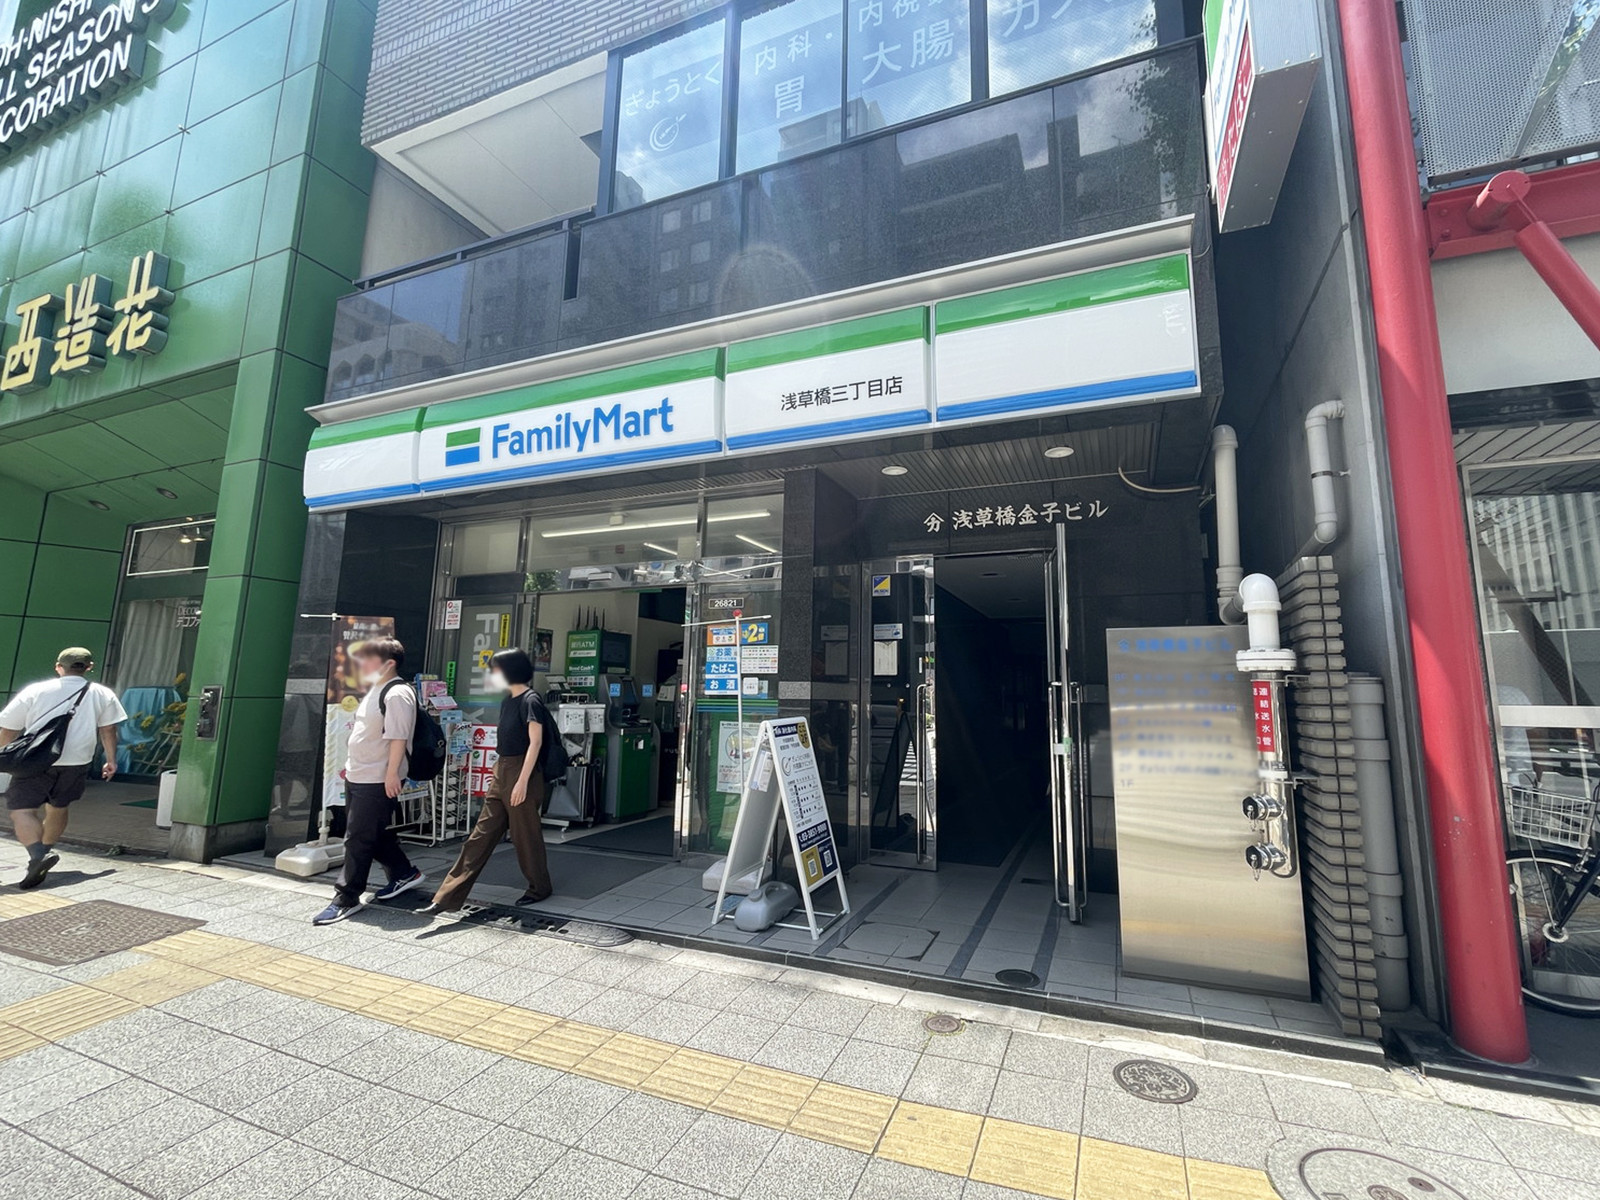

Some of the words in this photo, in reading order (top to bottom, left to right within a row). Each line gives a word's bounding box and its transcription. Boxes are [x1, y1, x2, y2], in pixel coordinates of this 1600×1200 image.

[774, 75, 805, 118] 胃
[862, 19, 955, 84] 大腸
[625, 62, 721, 117] ぎょうとく
[781, 376, 903, 412] 浅草橋三丁目店
[492, 397, 674, 459] FamilyMart
[952, 500, 1110, 531] 浅草橋金子ビル
[714, 599, 737, 608] 26821
[710, 680, 735, 690] お酒
[711, 663, 736, 674] たばこ
[1259, 687, 1271, 746] 連結送水管
